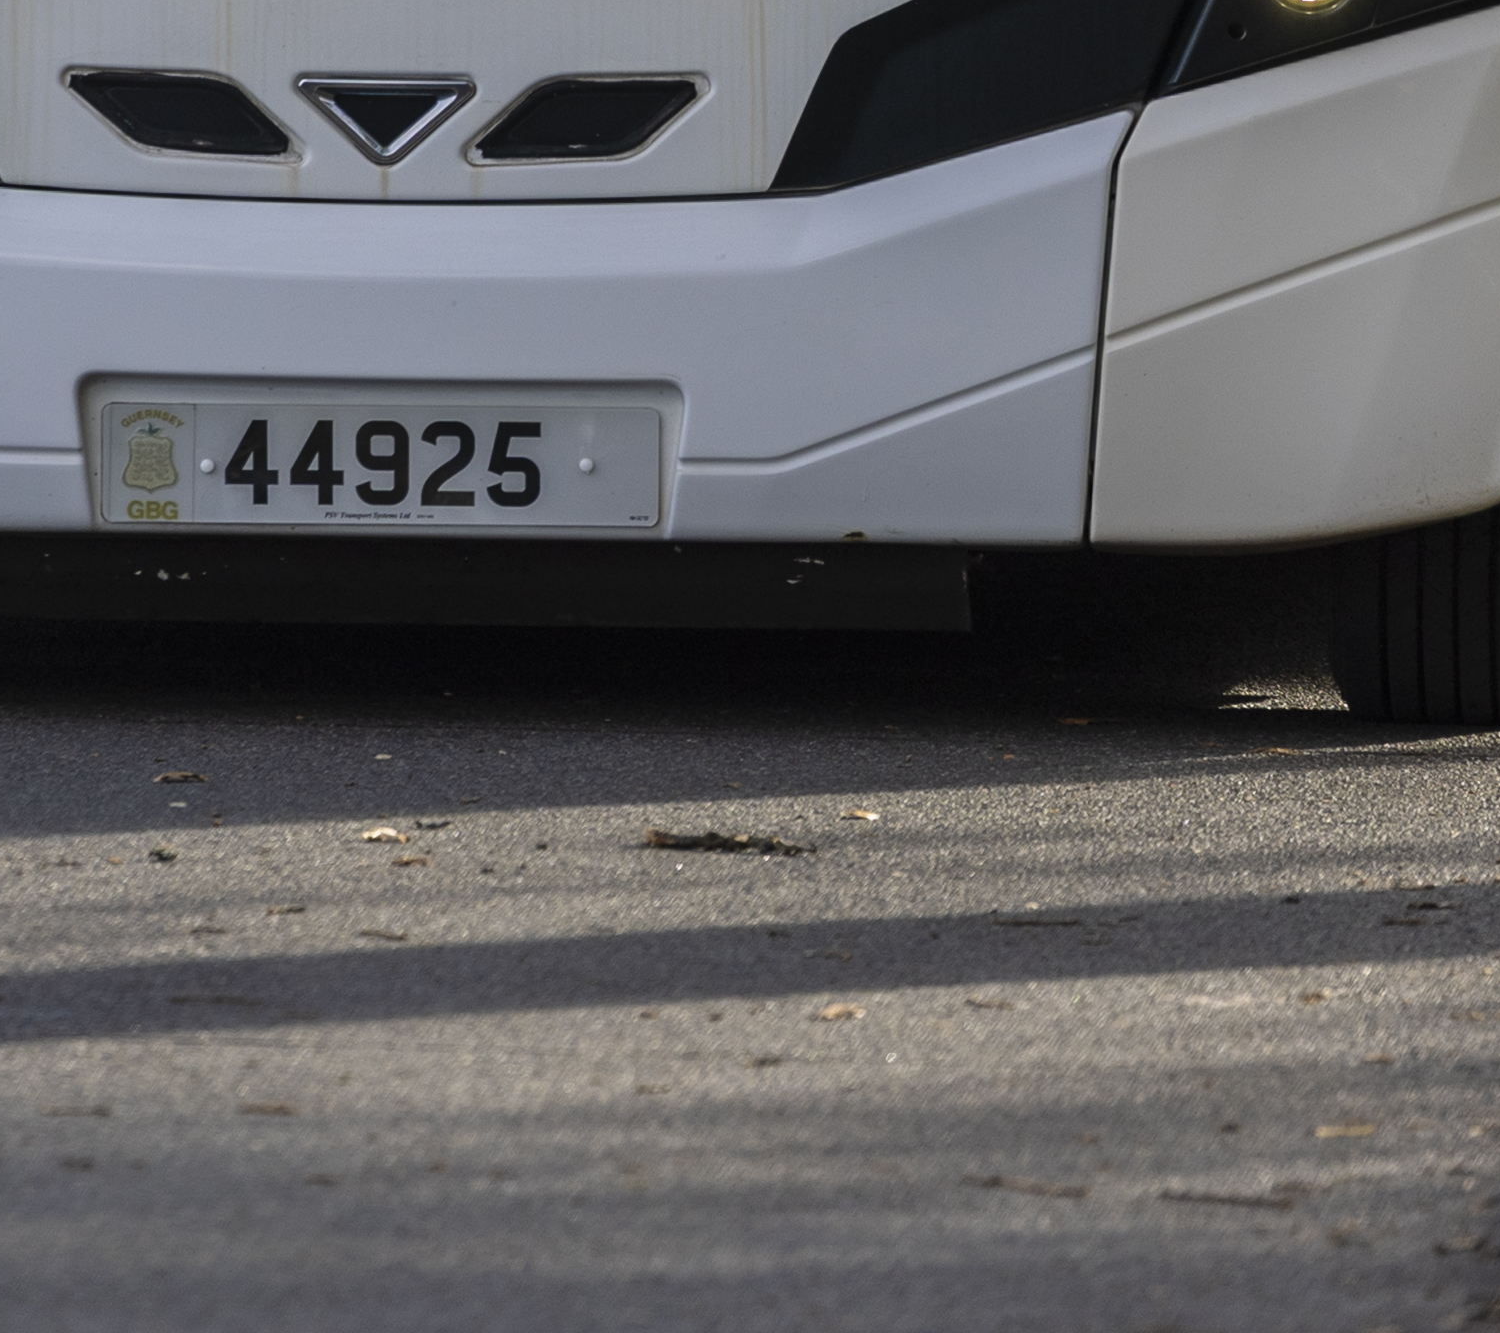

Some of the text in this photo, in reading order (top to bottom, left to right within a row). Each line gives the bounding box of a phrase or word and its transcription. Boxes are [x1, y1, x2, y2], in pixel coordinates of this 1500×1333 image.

[120, 409, 184, 428] GUERNSEY
[224, 419, 542, 507] 44925
[126, 499, 178, 520] GBG
